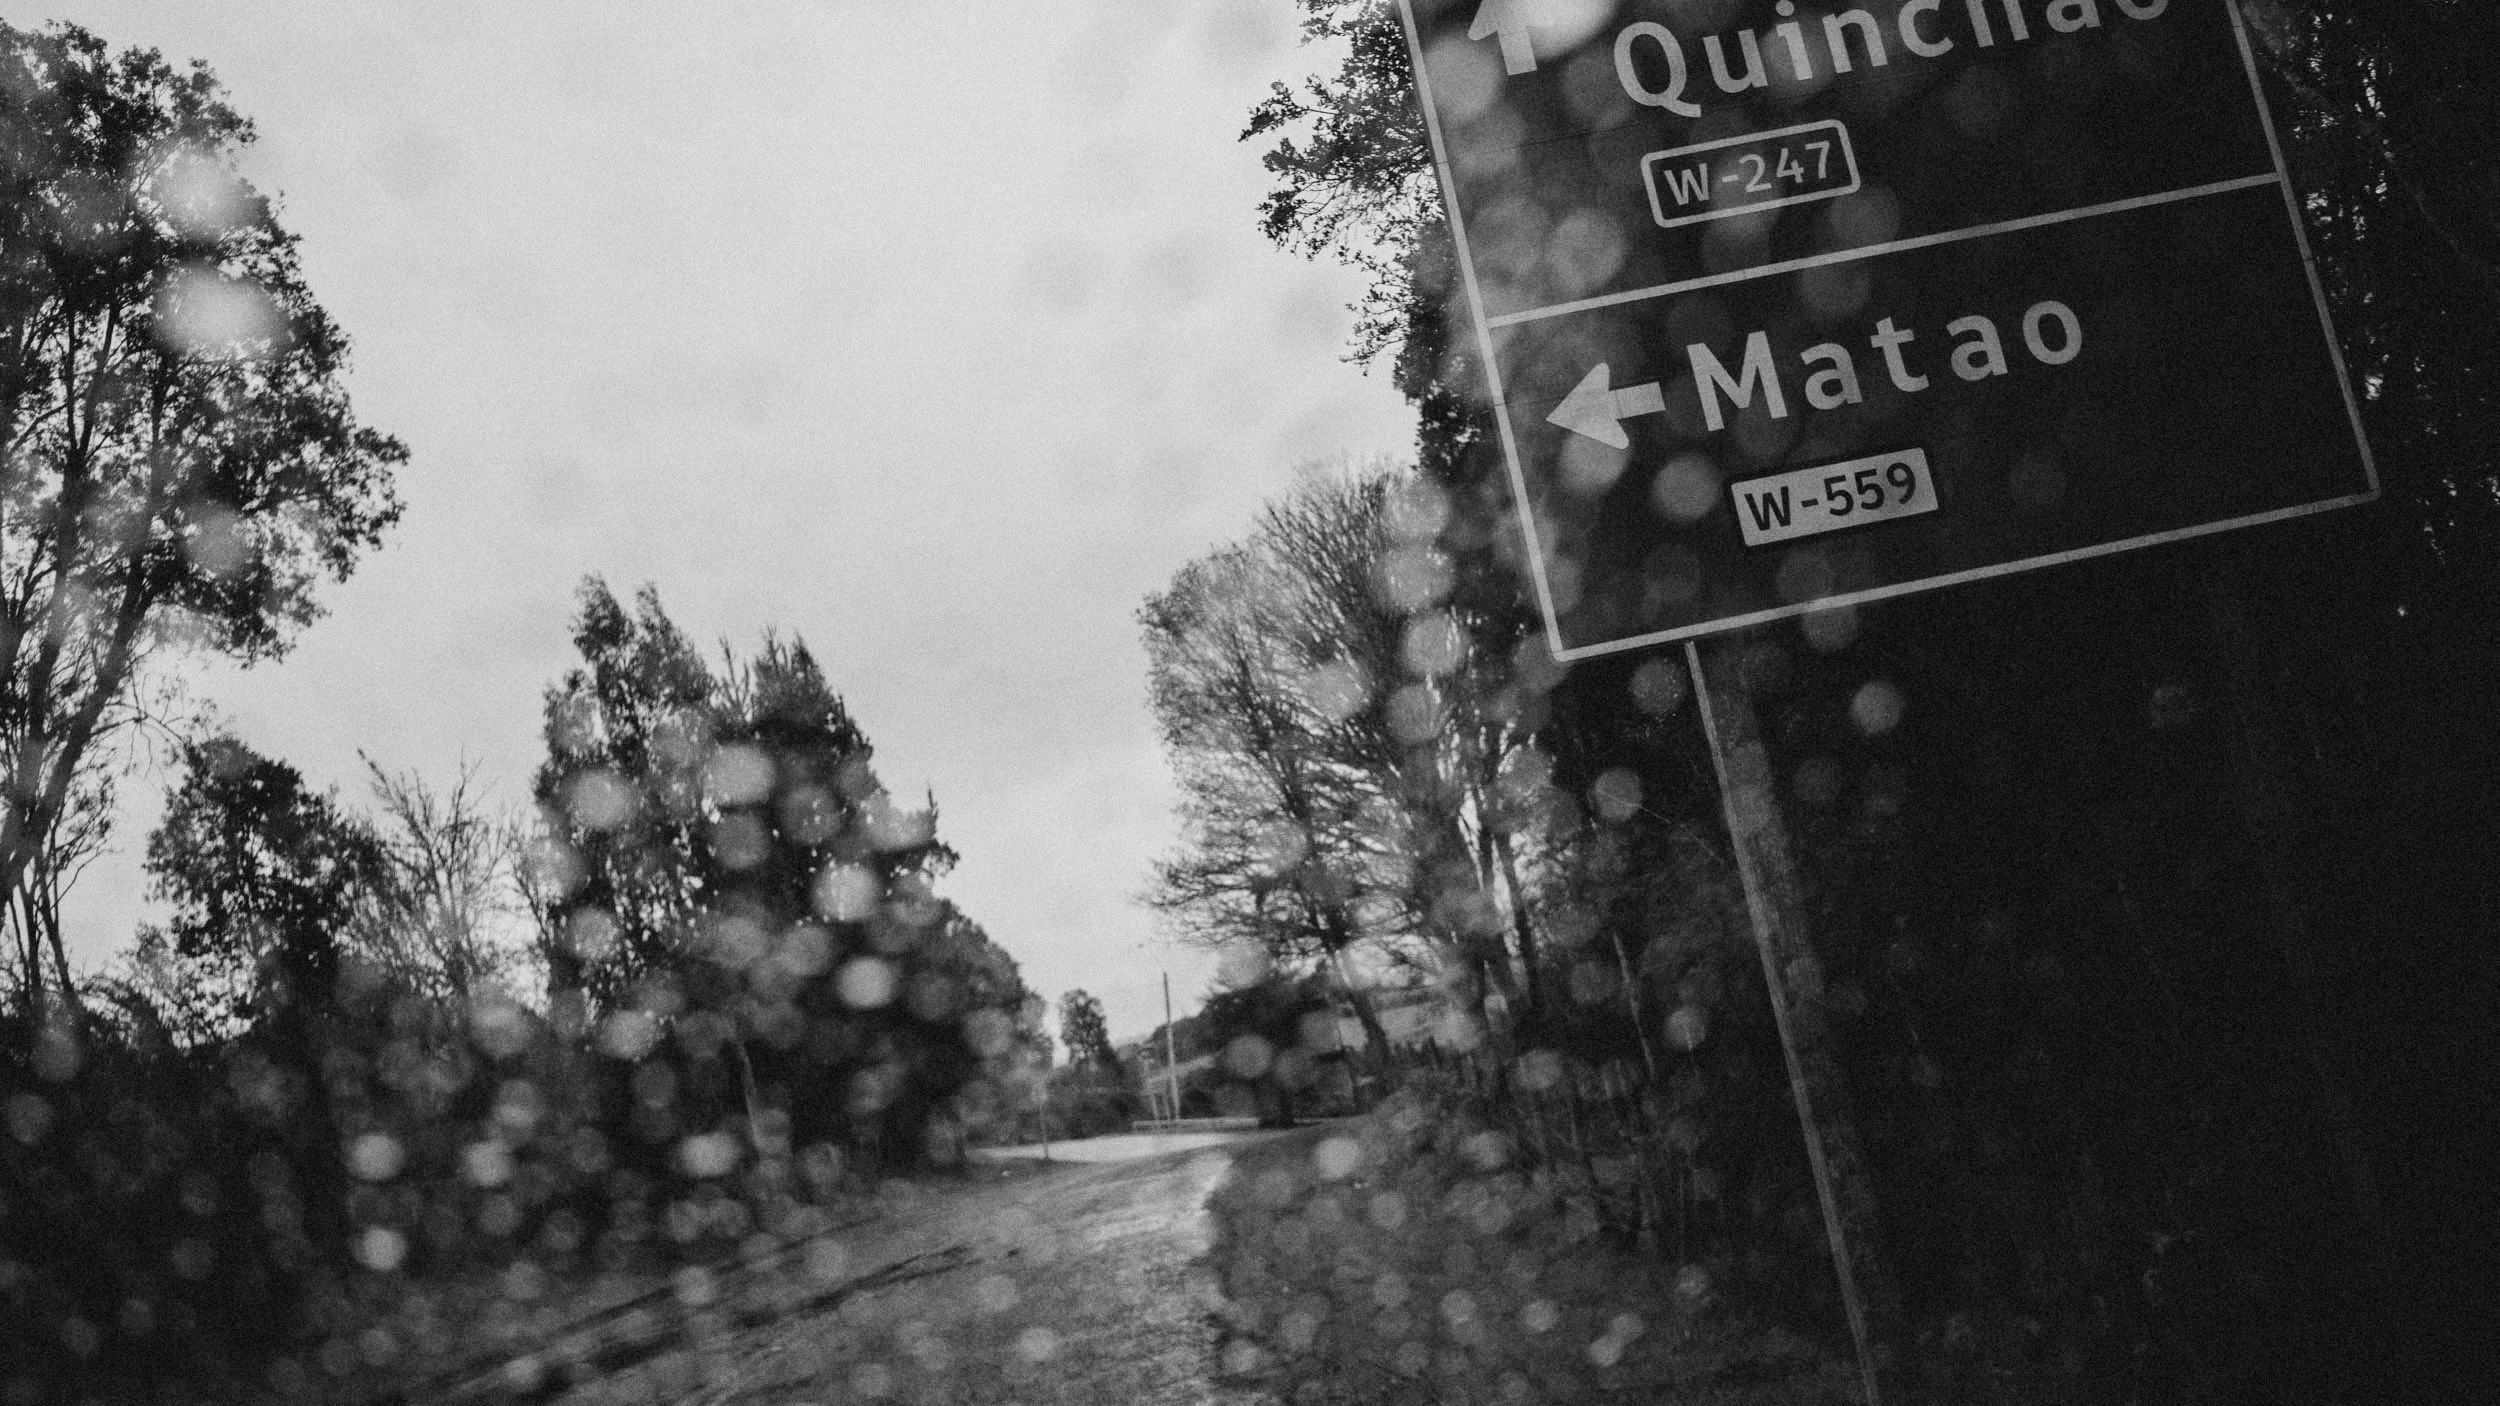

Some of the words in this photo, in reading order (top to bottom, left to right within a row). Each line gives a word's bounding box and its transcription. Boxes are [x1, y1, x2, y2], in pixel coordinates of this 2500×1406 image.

[1664, 141, 1833, 206] W-247
[1687, 300, 2083, 432] Matao
[1745, 463, 1917, 532] W-559
